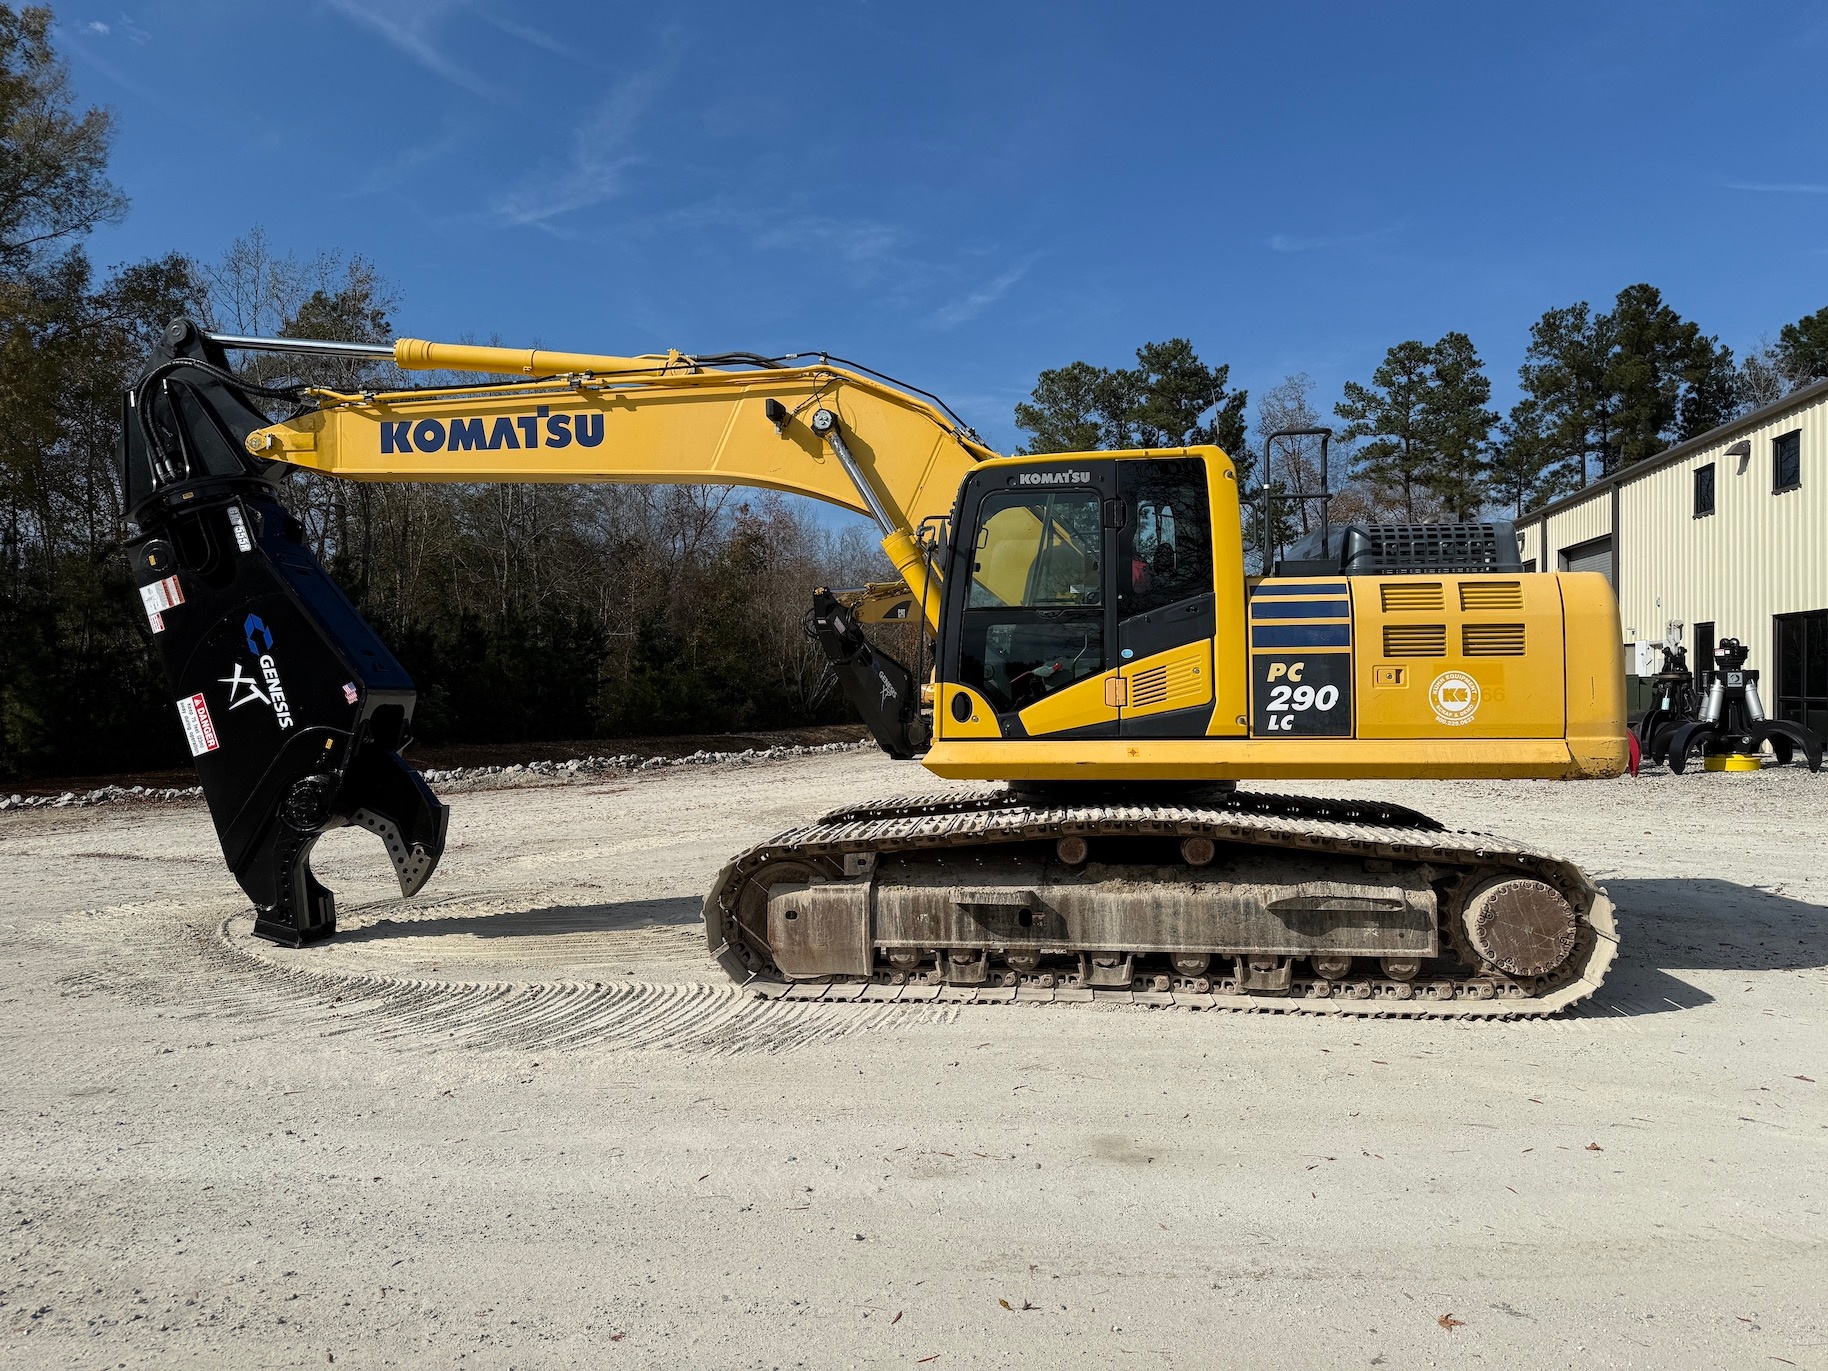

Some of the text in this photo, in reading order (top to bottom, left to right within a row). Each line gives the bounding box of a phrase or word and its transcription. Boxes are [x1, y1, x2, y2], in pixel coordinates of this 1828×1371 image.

[380, 405, 605, 454] KOMATSU
[1019, 469, 1091, 485] KOMATSU
[1267, 662, 1305, 682] PC
[259, 654, 294, 730] GENESIS
[1432, 674, 1477, 695] KUHN EQUIPMENT
[185, 702, 194, 715] Keep
[1266, 685, 1340, 711] 290
[1436, 704, 1453, 717] SCRAP
[196, 706, 216, 747] DANGER
[1268, 714, 1295, 731] LC
[183, 715, 192, 730] during
[188, 731, 199, 754] operation
